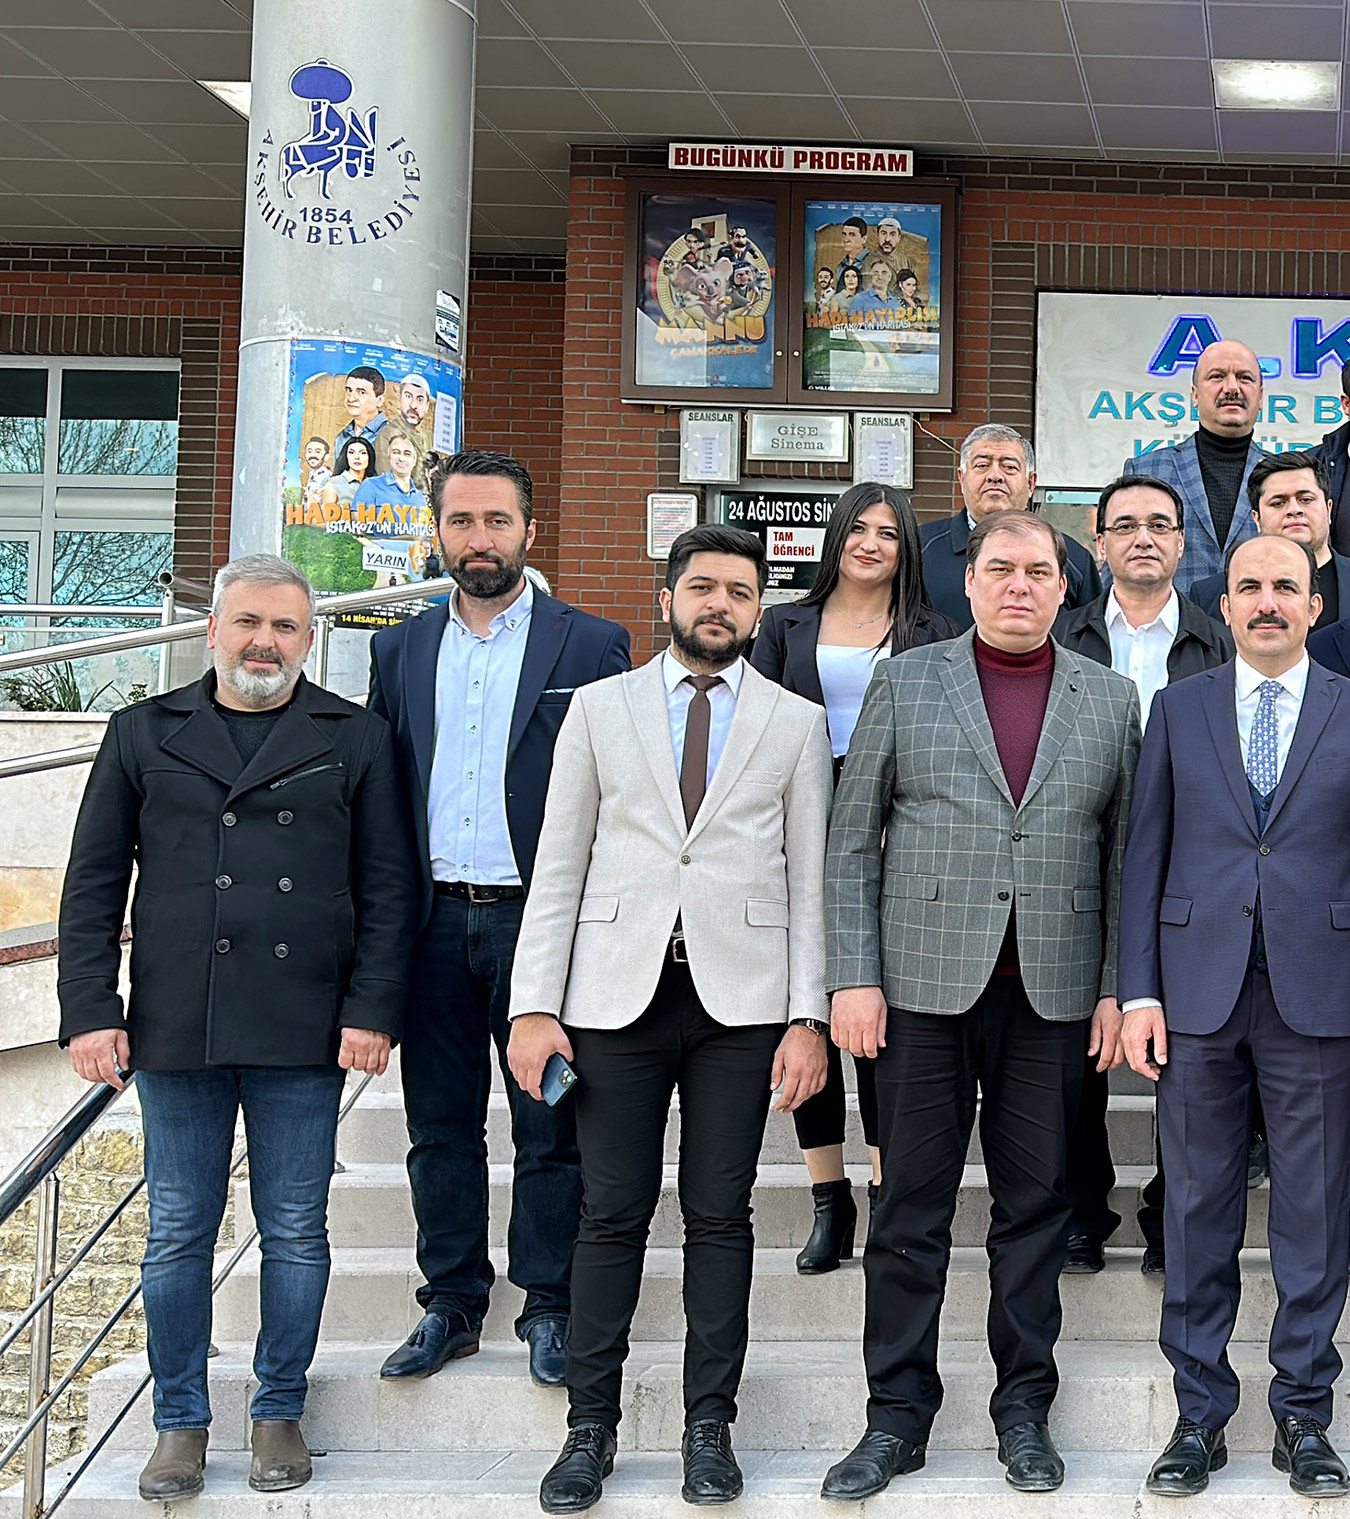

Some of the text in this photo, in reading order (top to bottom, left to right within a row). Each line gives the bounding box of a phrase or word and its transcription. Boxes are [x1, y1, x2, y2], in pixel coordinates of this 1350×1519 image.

[674, 145, 908, 173] BUGÜNKÜ PROGRAM
[254, 129, 421, 246] AKŞEHİR BELEDİYESİ
[299, 207, 353, 225] 1854
[1087, 390, 1299, 428] AKŞR
[688, 412, 734, 423] SEANSLAR
[861, 417, 906, 427] SEANSLAR
[777, 423, 818, 439] GİŞE
[771, 438, 825, 450] Sinema
[357, 502, 434, 525] HAYIR
[728, 495, 836, 522] 24 AĞUSTOS SİN
[773, 531, 794, 542] TAM
[773, 544, 815, 557] ÖĞRENCİ
[366, 552, 407, 567] YARIN
[342, 614, 351, 622] 14
